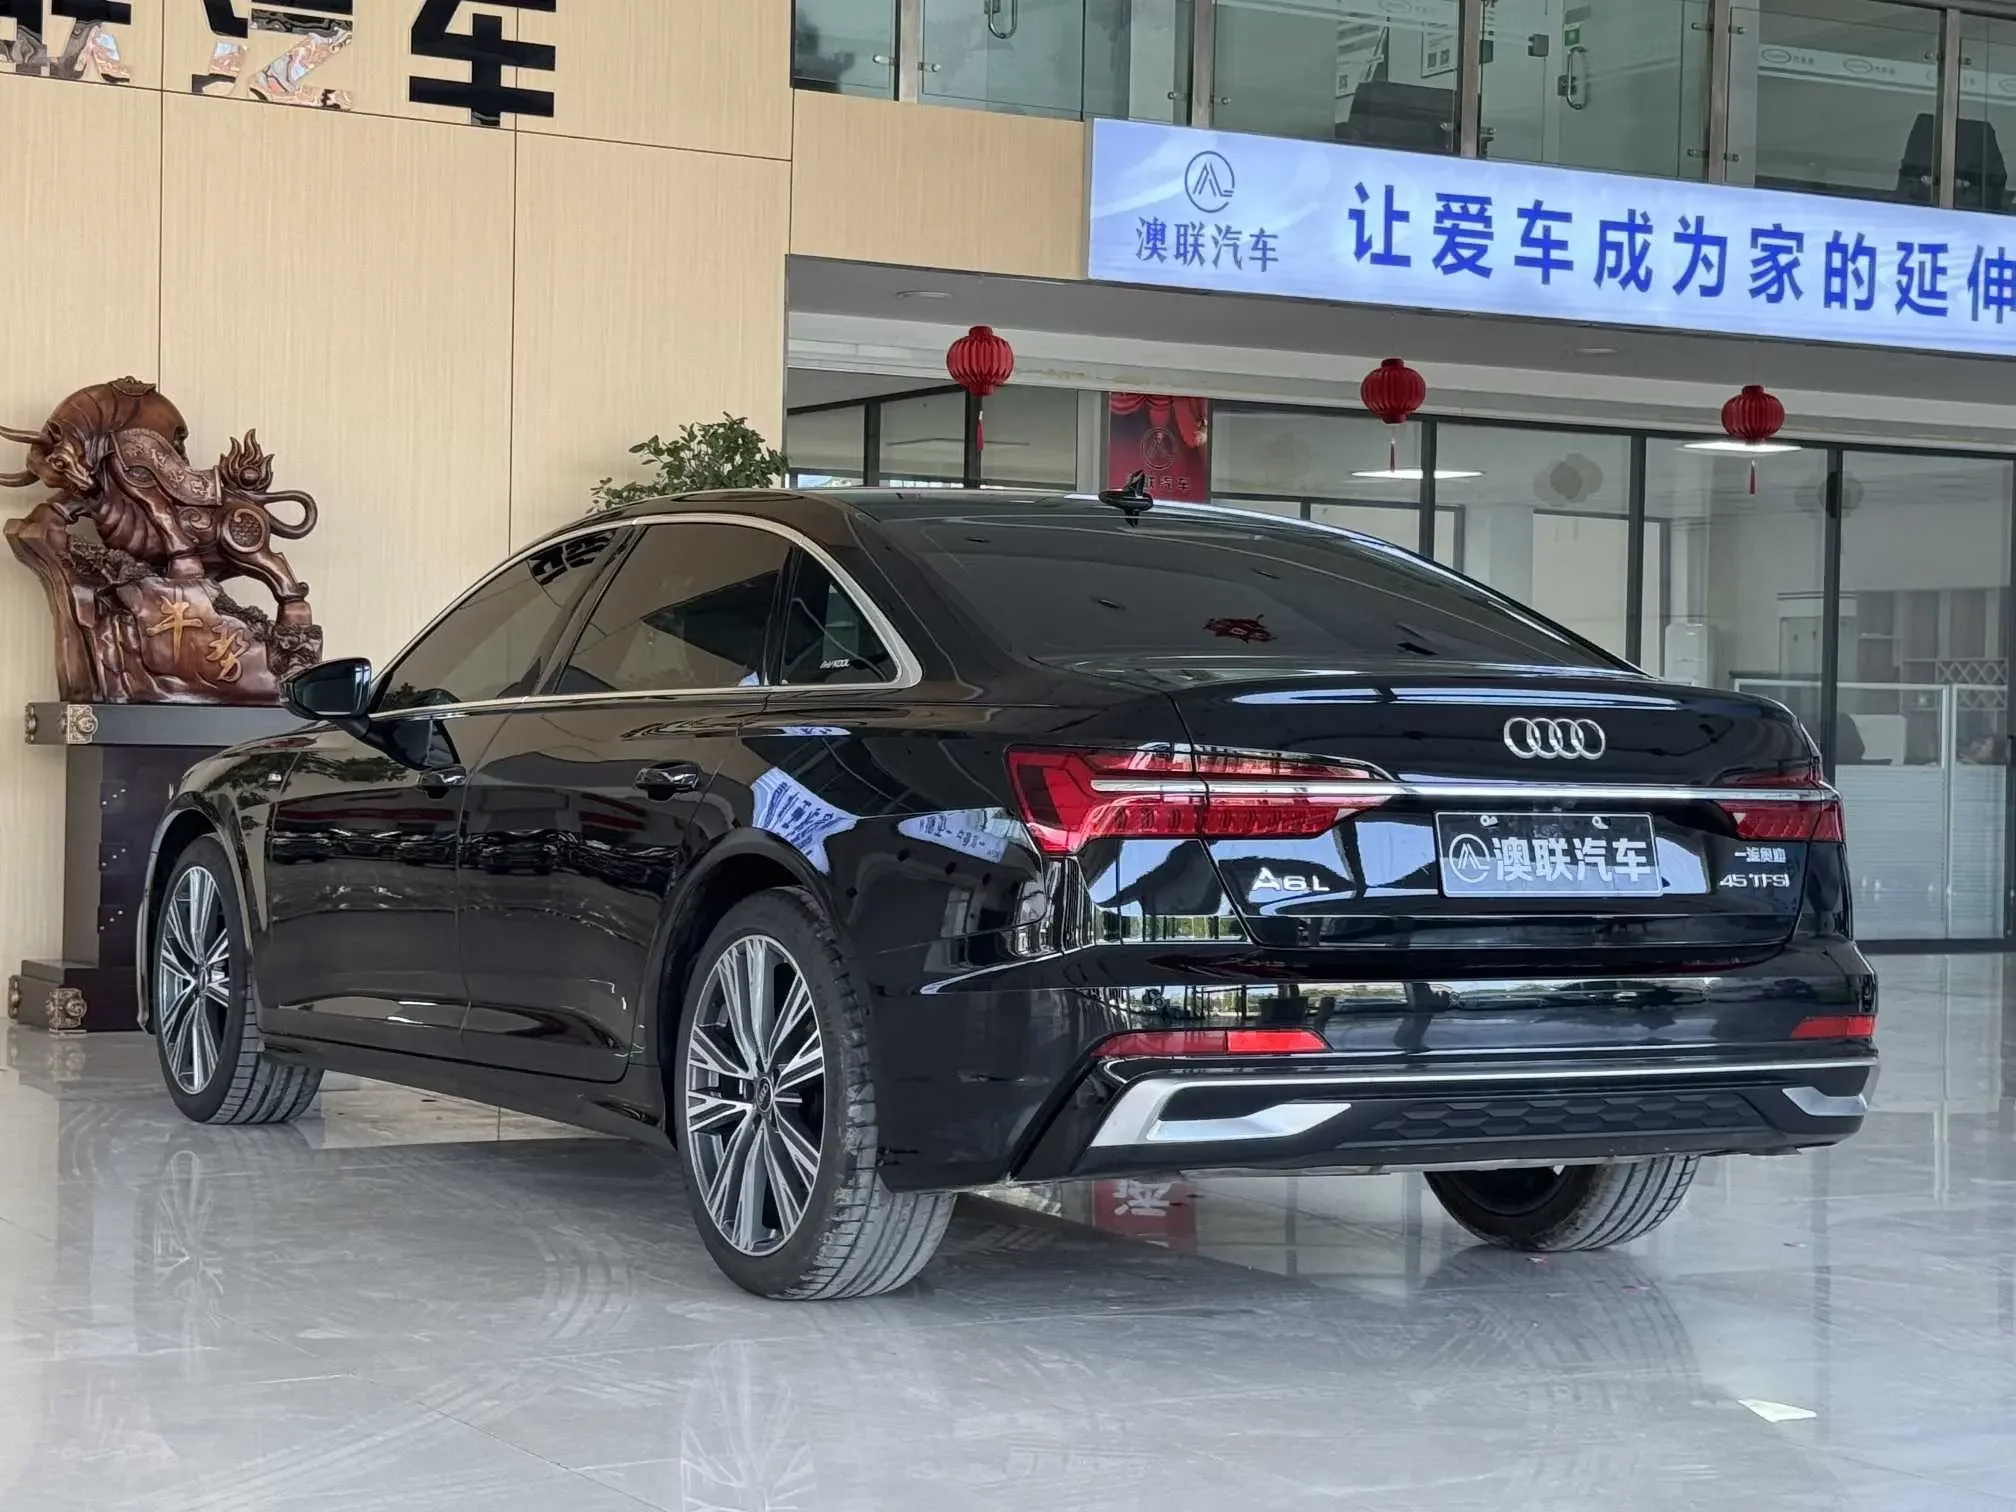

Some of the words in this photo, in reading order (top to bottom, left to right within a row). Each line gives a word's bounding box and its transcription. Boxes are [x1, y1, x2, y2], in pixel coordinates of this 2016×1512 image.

[1135, 217, 1279, 273] 澳联汽车
[1347, 181, 2016, 324] 让爱车成为家的延伸
[1492, 836, 1652, 884] 澳联汽车
[1718, 873, 1748, 888] 45
[1749, 873, 1790, 888] TFSI
